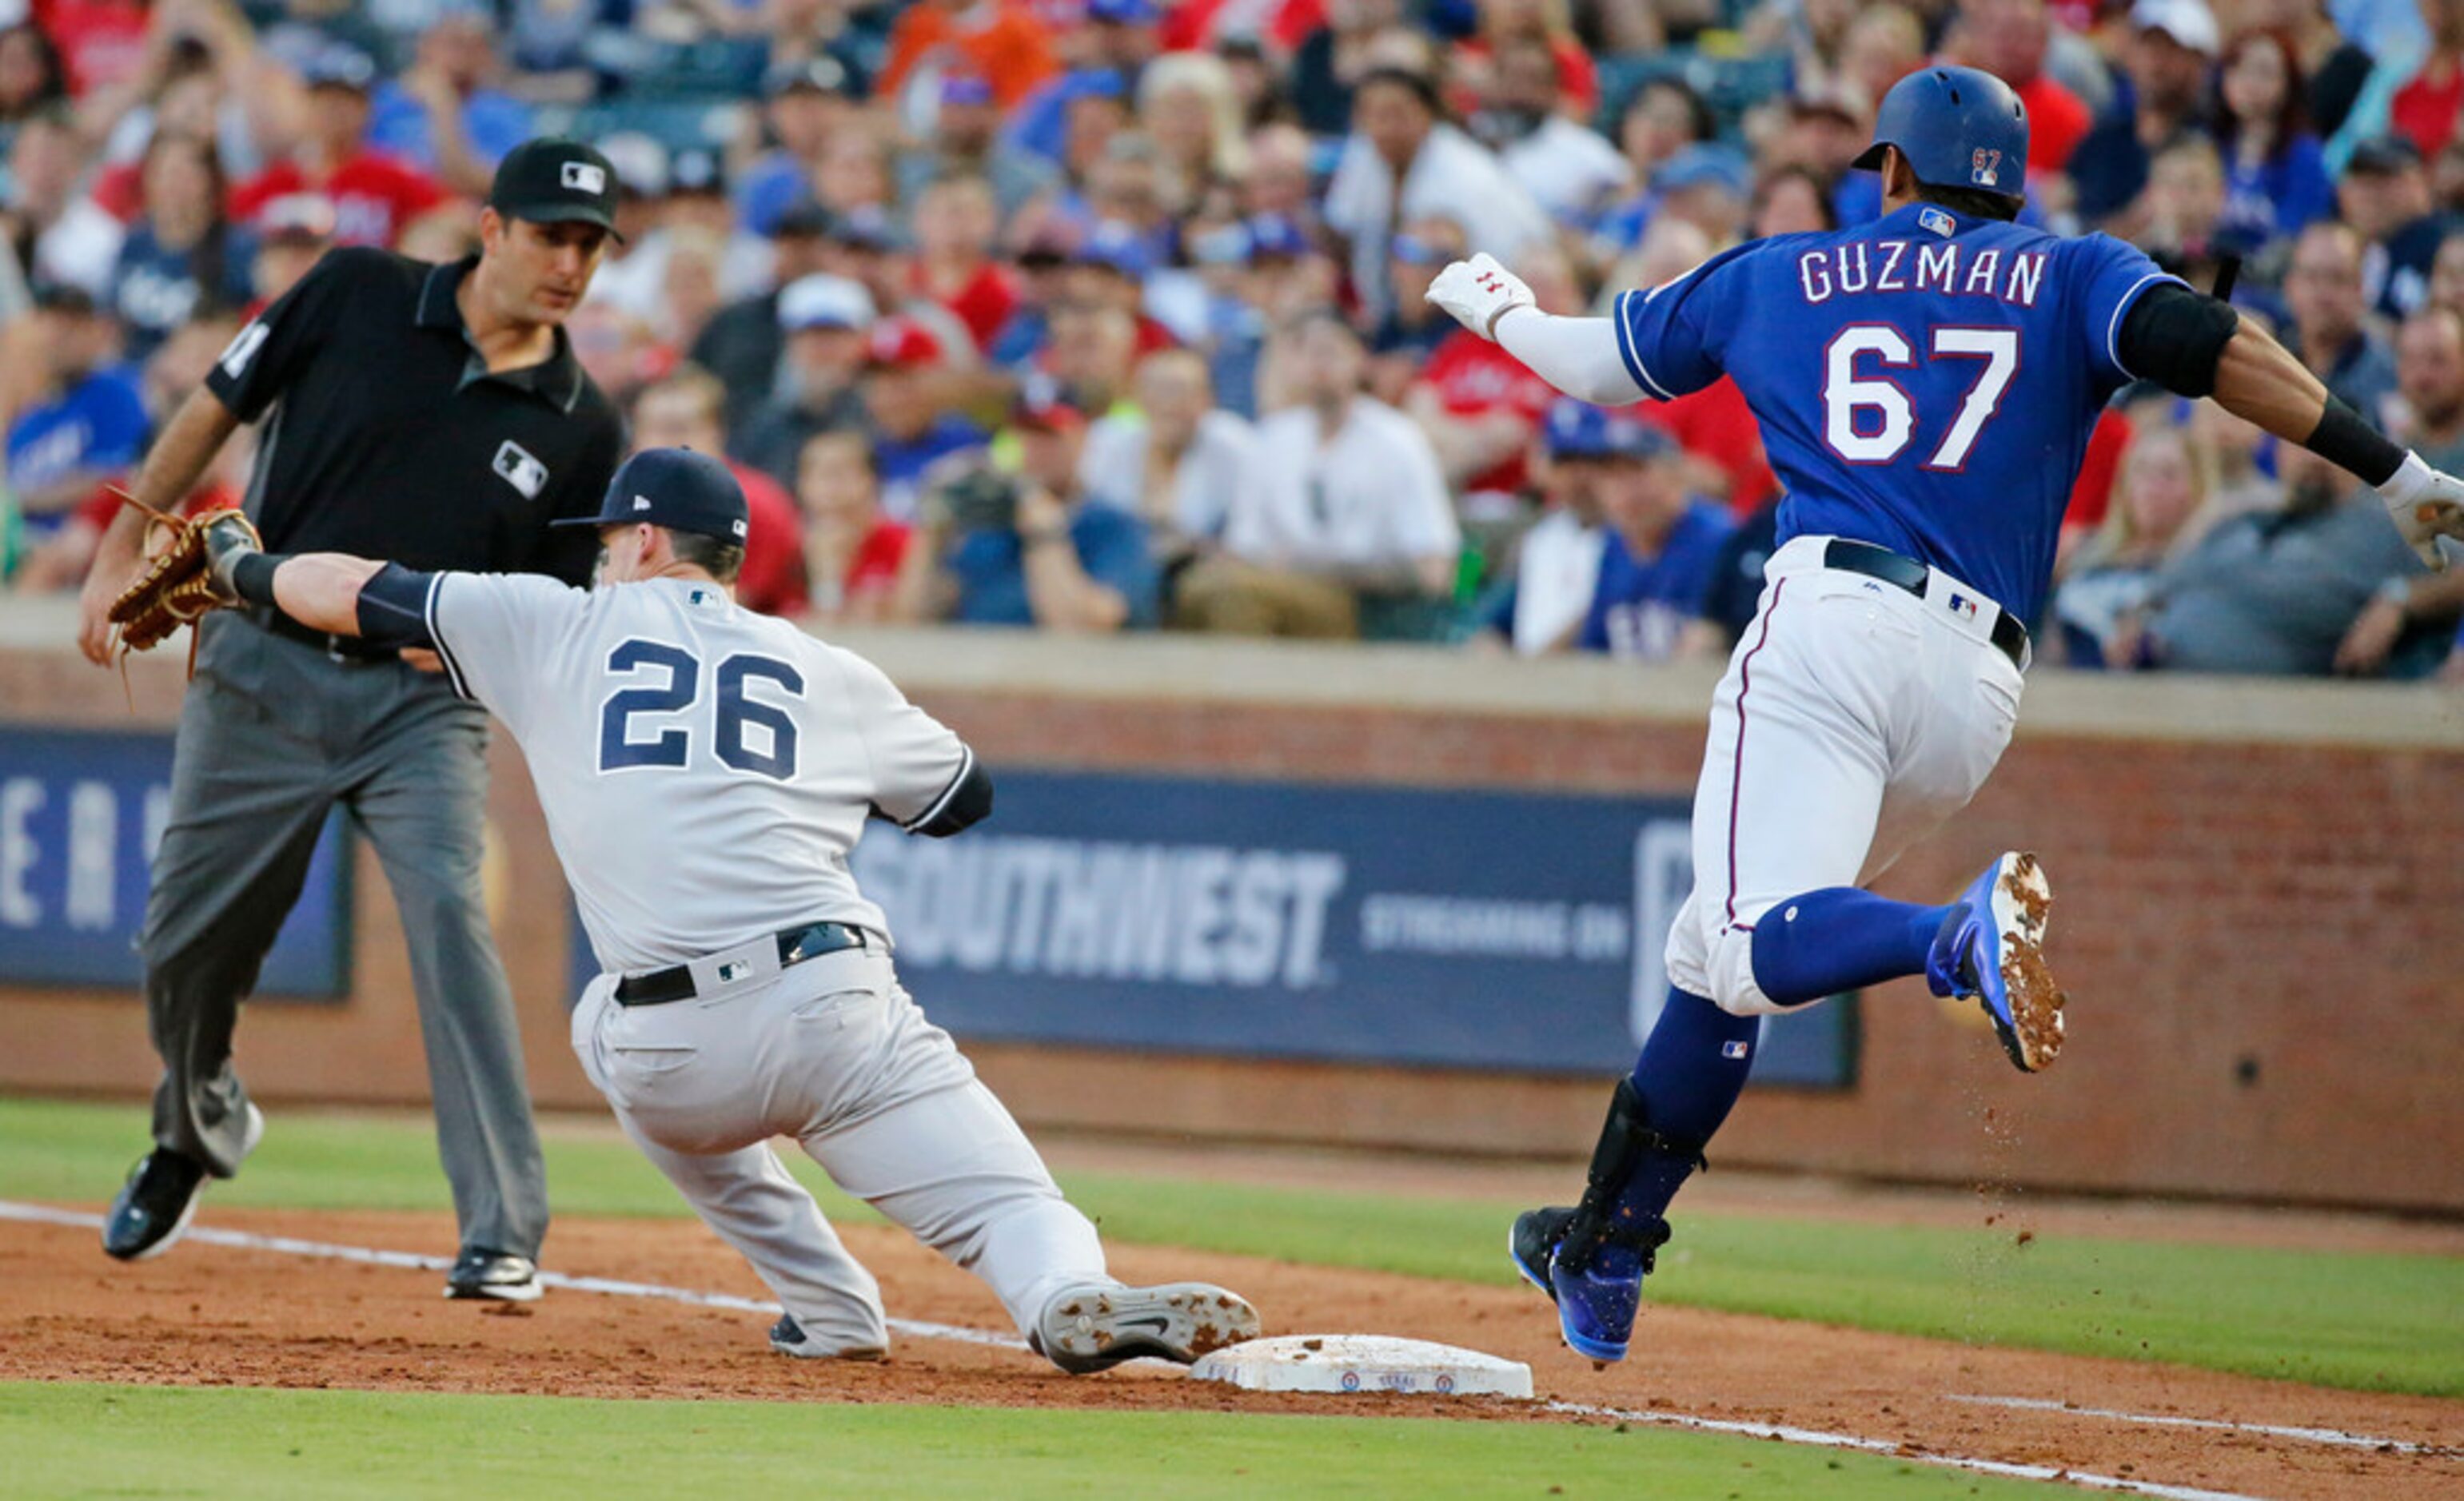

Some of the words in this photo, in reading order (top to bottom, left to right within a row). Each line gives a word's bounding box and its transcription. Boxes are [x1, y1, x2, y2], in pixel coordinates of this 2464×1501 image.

[1972, 147, 2002, 169] 67
[1800, 241, 2047, 307] GUZMAN
[1820, 322, 2021, 472] 67
[597, 635, 806, 783] 26
[849, 826, 1346, 989] SOUTHWEST
